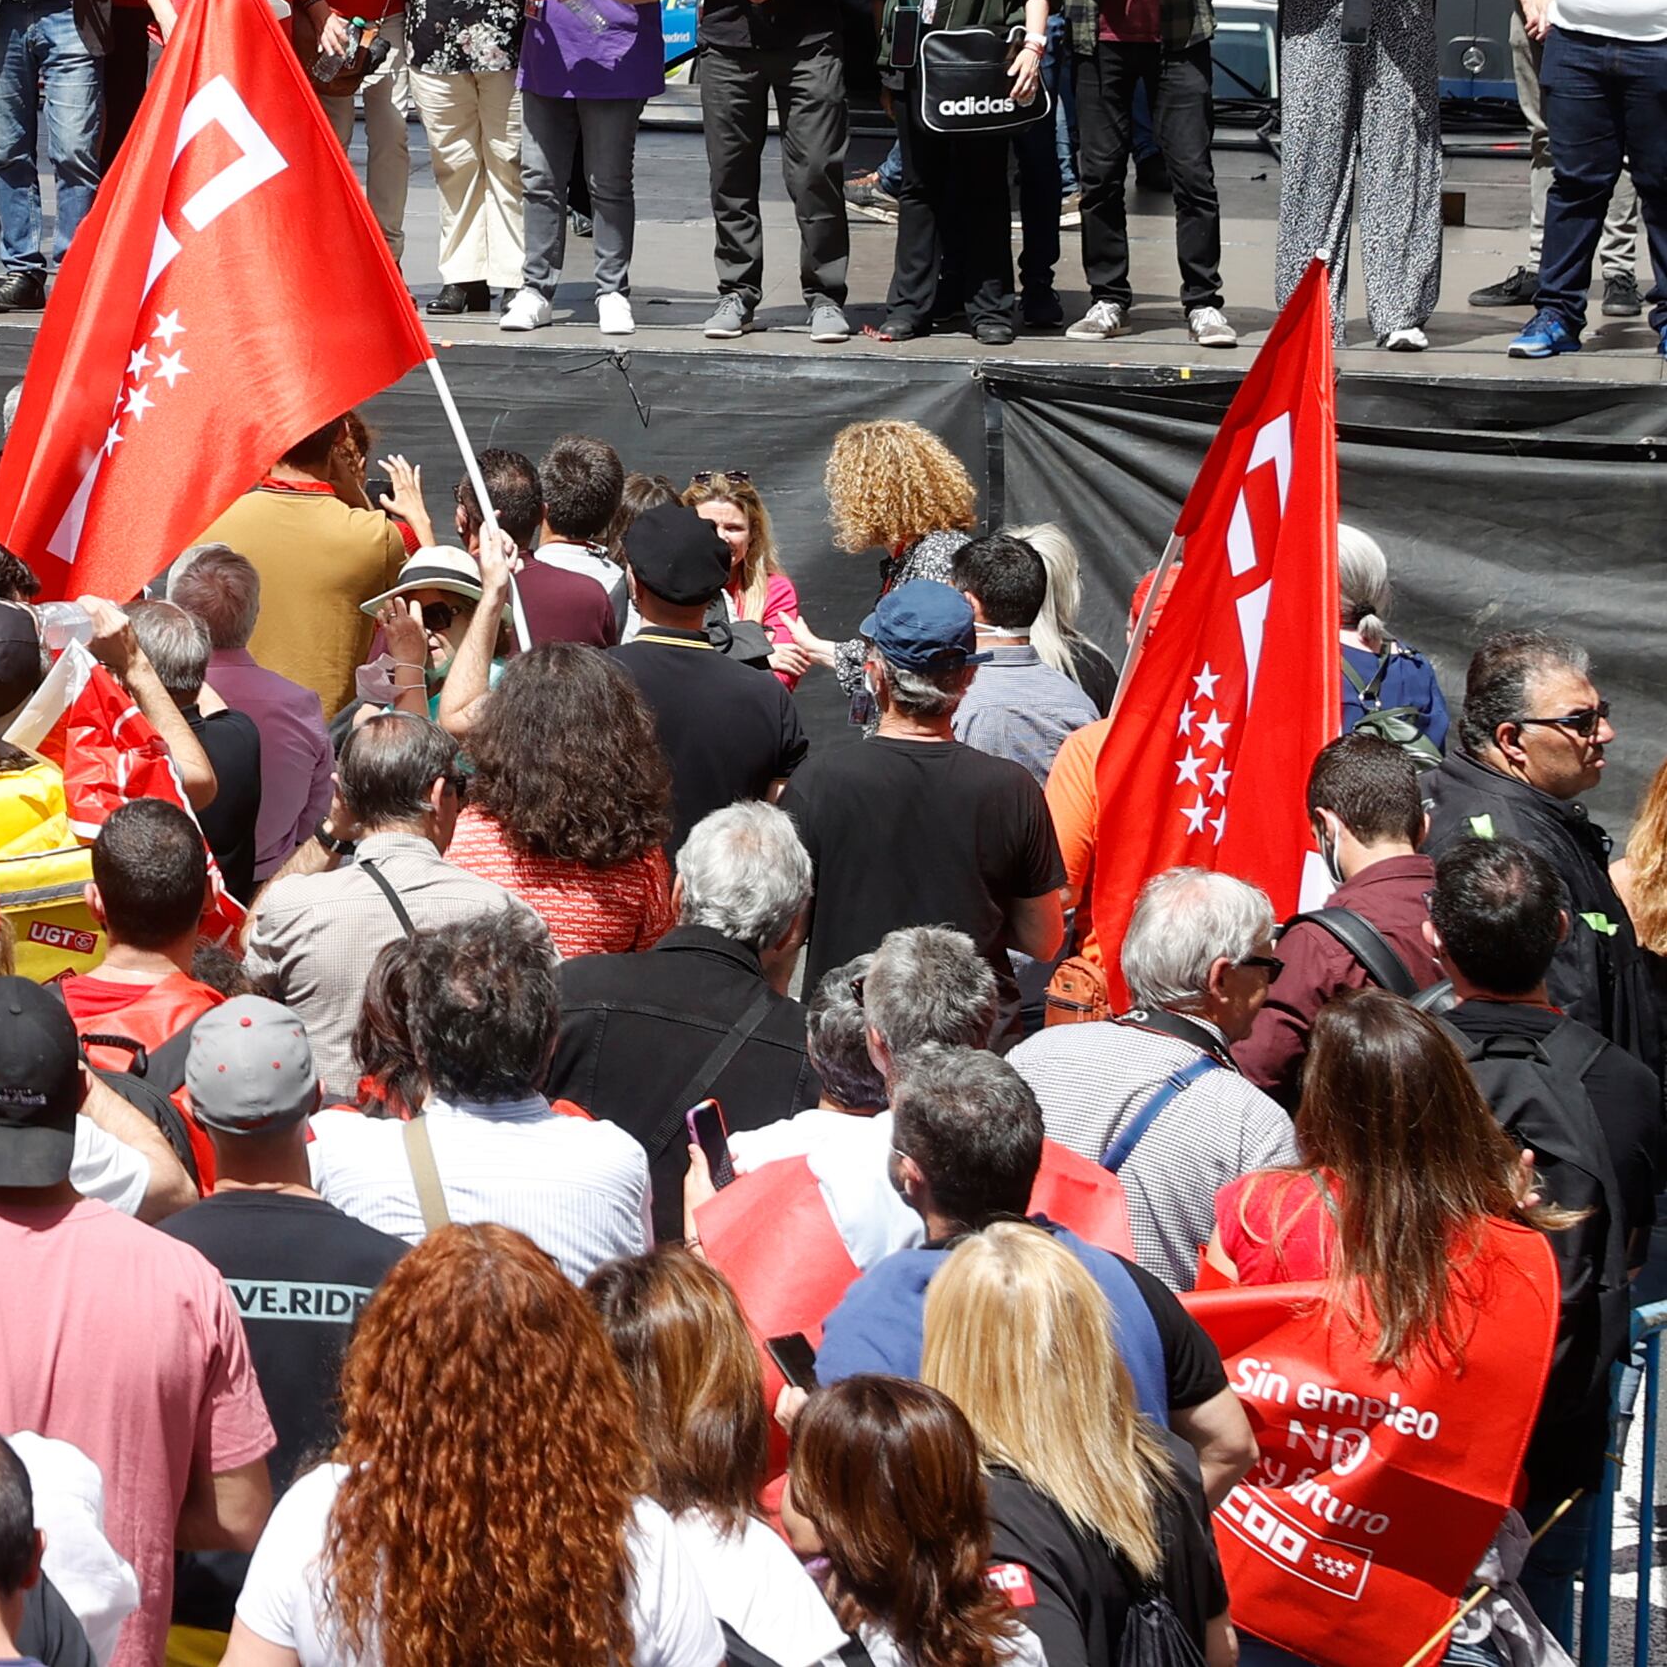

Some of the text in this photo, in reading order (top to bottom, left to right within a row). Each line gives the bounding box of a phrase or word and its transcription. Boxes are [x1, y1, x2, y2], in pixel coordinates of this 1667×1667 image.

[938, 96, 1014, 117] adidas
[30, 922, 75, 946] UGT
[1229, 1357, 1441, 1441] Sin empleo
[1283, 1465, 1391, 1536] futuro
